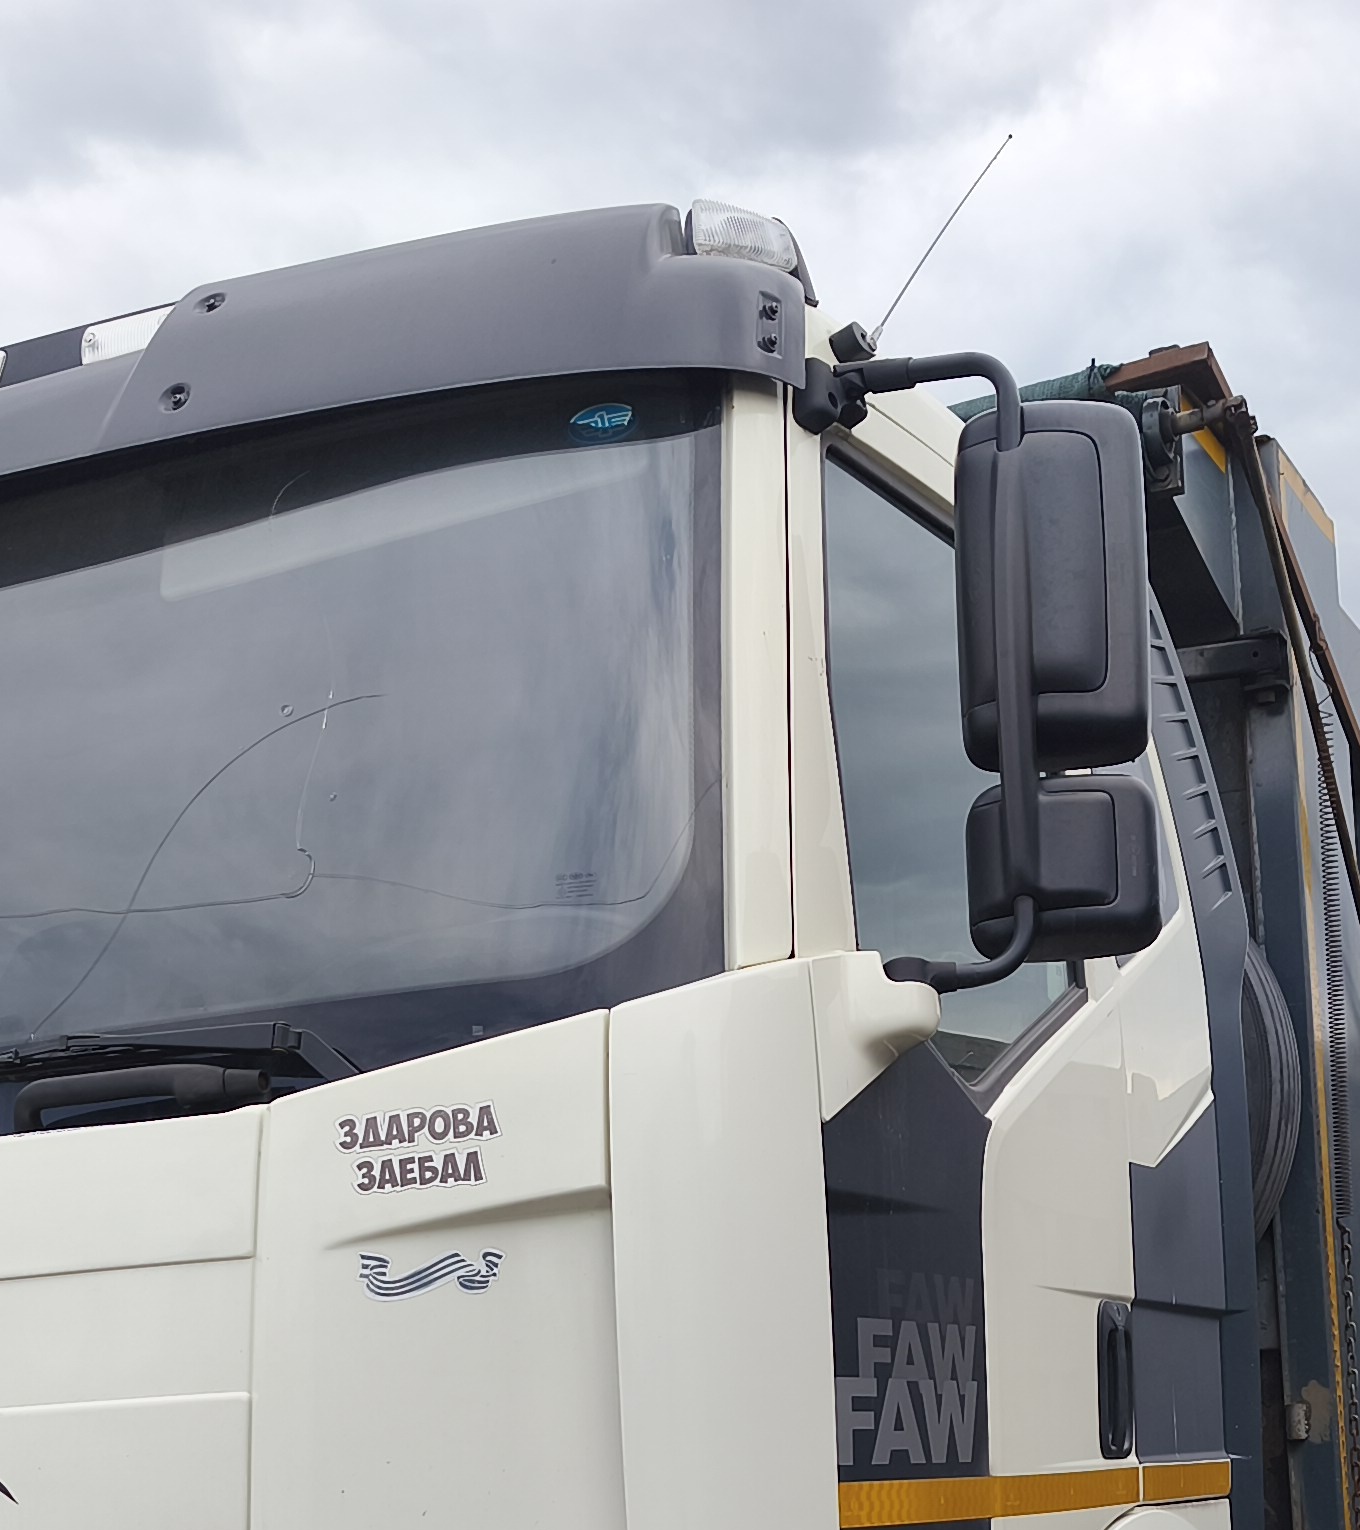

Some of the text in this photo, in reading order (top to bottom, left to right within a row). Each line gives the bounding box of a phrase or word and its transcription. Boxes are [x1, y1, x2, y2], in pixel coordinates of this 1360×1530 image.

[338, 1104, 499, 1151] ЗДАРОВА
[356, 1149, 484, 1192] ЗАЕБАЛ
[876, 1267, 975, 1338] FAW
[856, 1316, 977, 1396] FAW
[835, 1376, 978, 1466] FAW
